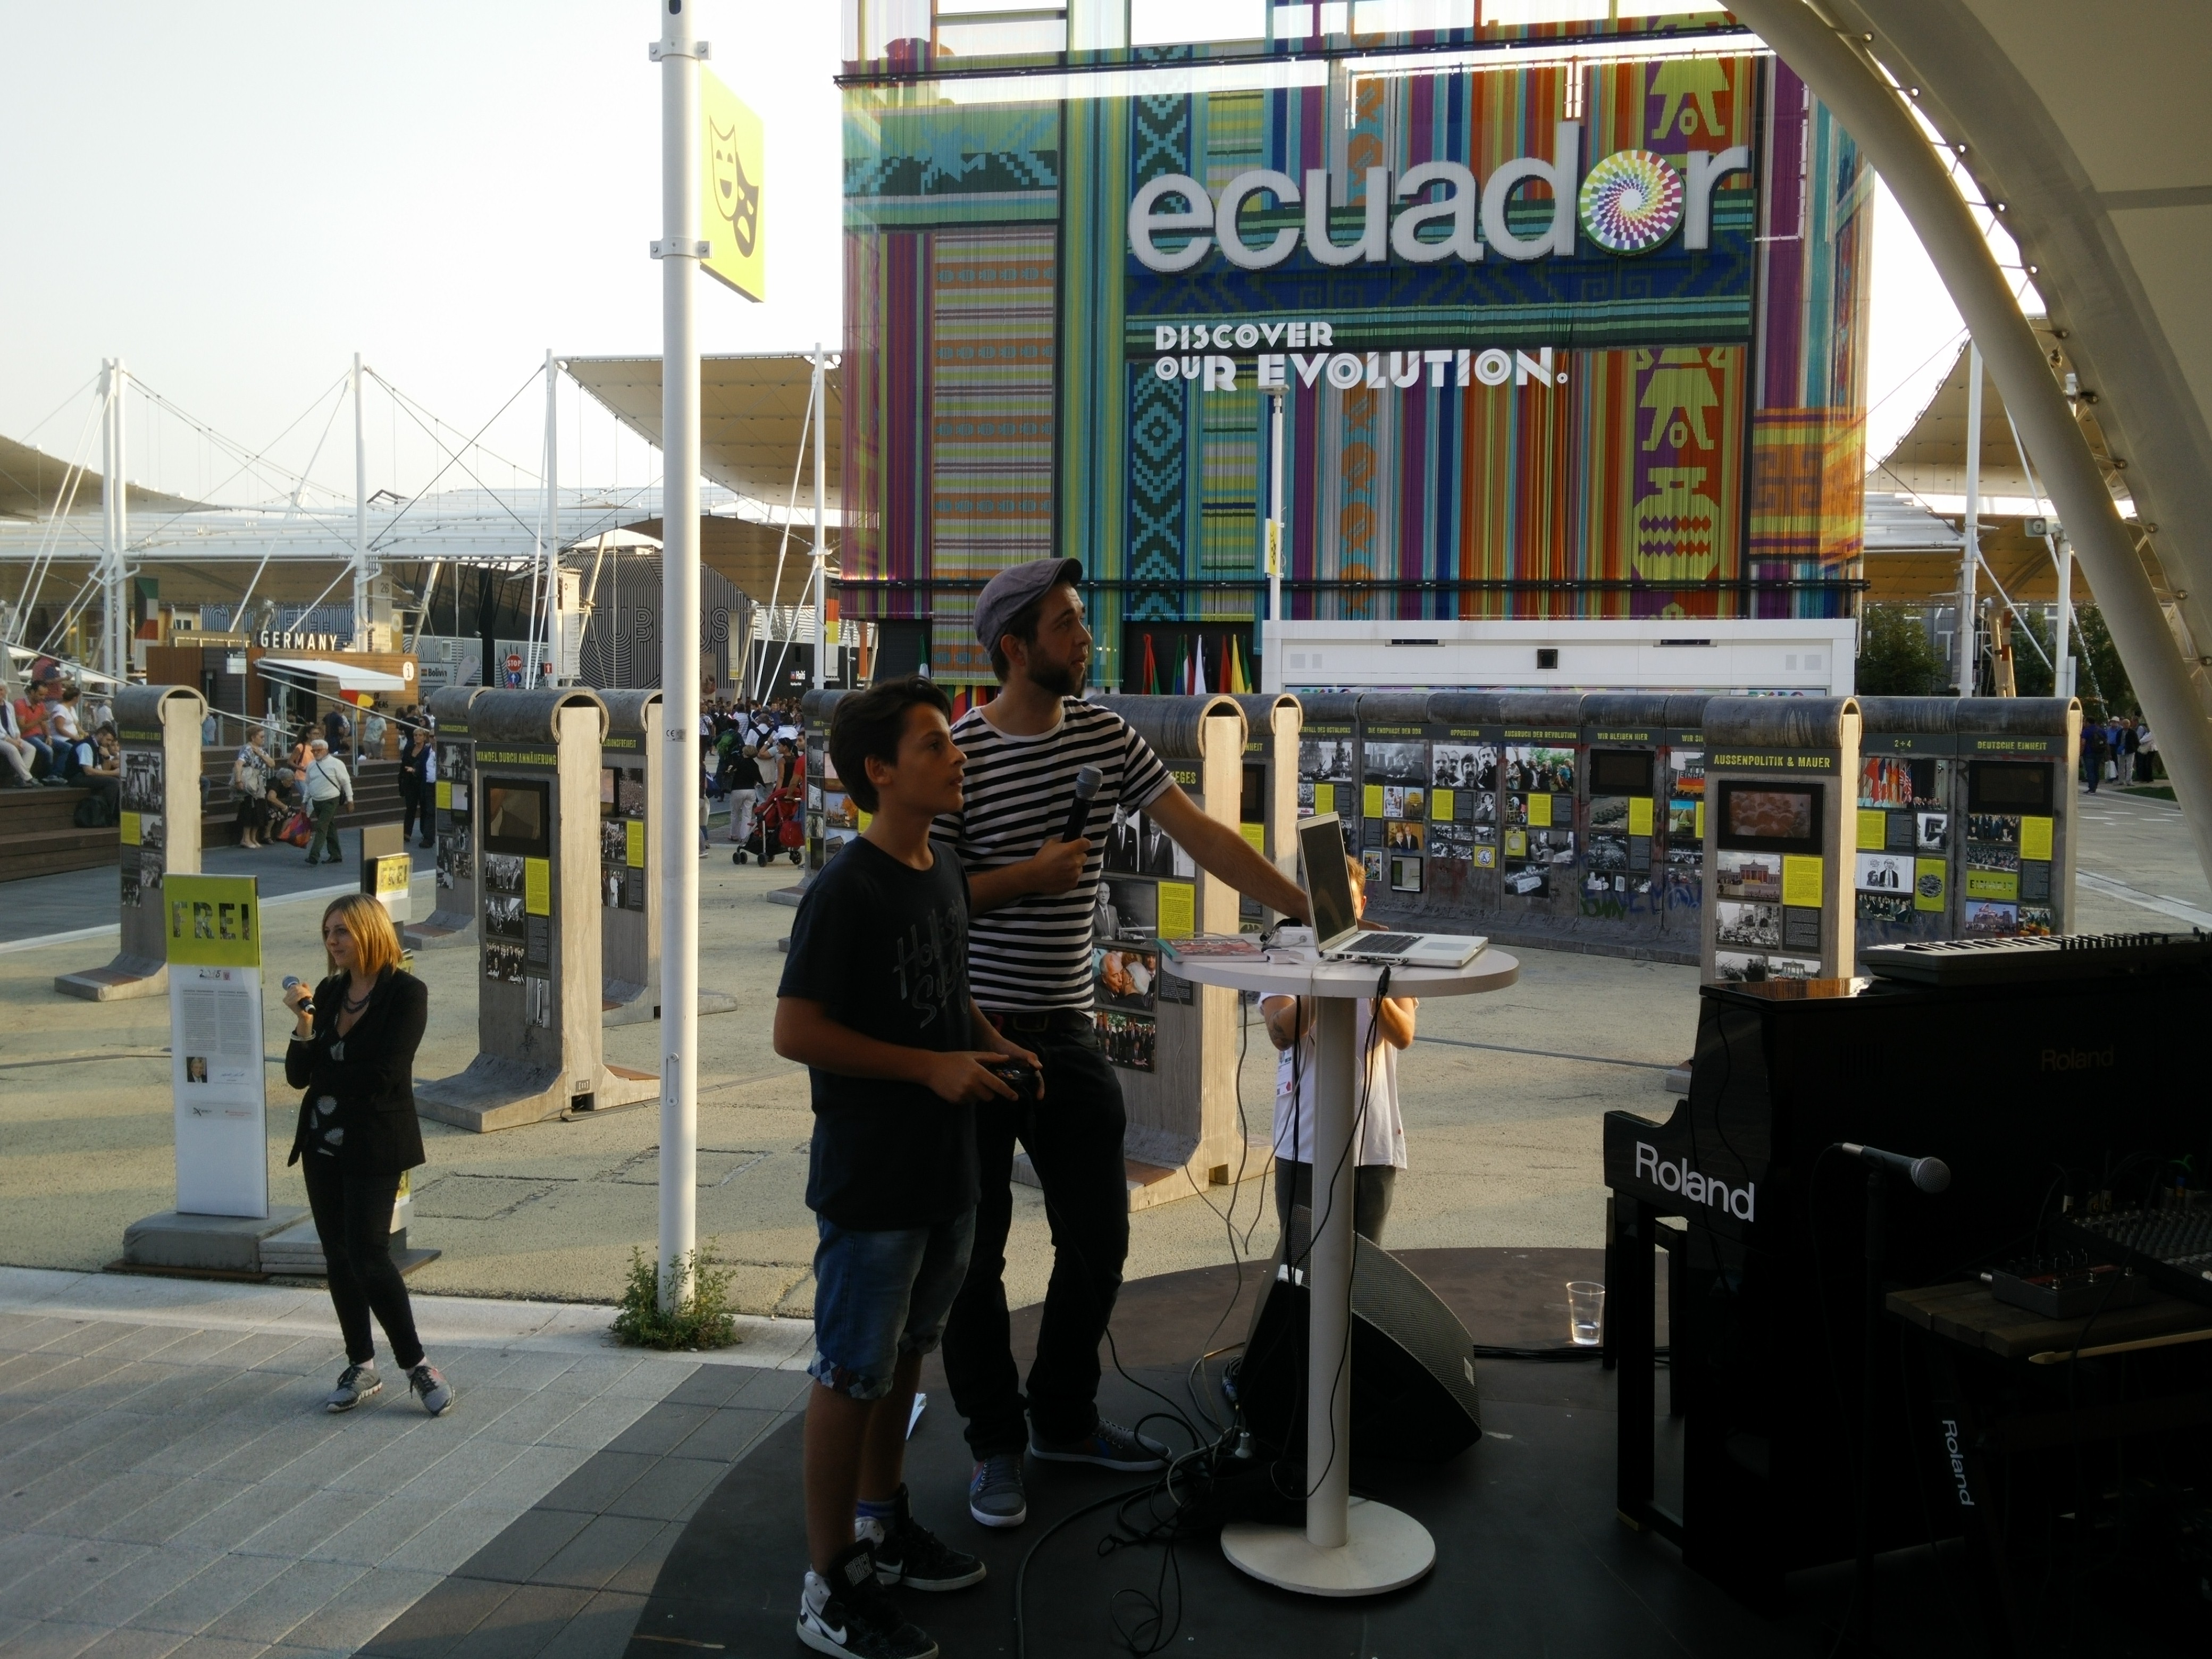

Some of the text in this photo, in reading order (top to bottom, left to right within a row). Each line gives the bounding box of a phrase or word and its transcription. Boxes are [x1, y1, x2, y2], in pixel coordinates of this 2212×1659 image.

[1127, 120, 1749, 273] ecuador
[1155, 322, 1333, 350] DISCOVER
[1155, 347, 1568, 392] OUR EVOLUTION.
[381, 583, 389, 593] 26
[261, 631, 337, 651] GERMANY
[604, 739, 636, 748] LIGIONSFREIHEIT
[1245, 743, 1263, 751] NHEIT
[1977, 741, 2047, 750] DEUTSCHE EINHEIT
[476, 750, 557, 766] WANDEL DURCH ANNÄHERUNG
[1714, 755, 1830, 768] AUSSENPOLITIK & MAUER
[381, 865, 408, 886] FREI
[172, 901, 250, 941] FREI
[2040, 1044, 2115, 1072] Roland
[1636, 1141, 1755, 1222] Roland
[1942, 1420, 1975, 1506] Roland
